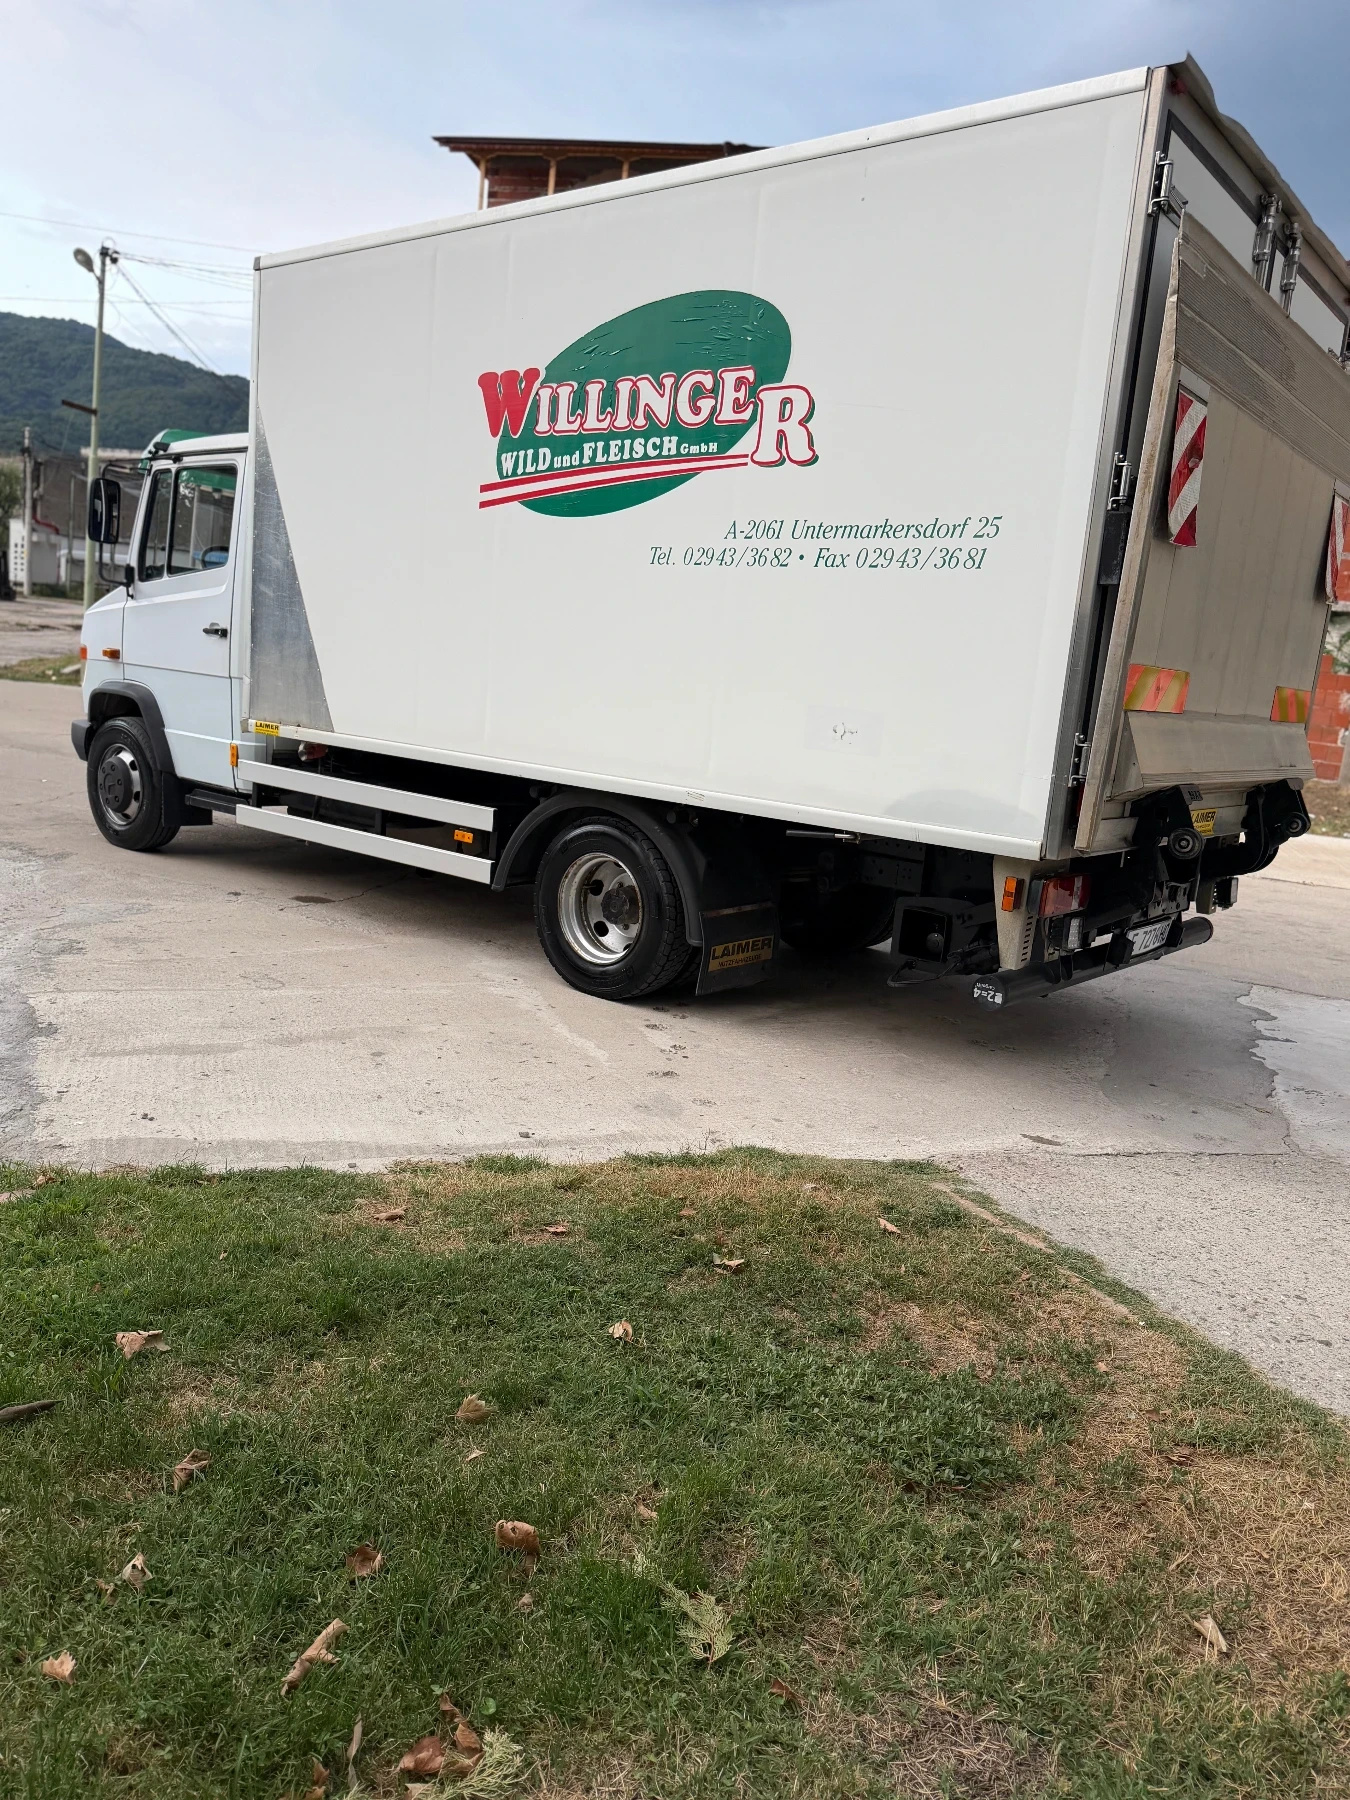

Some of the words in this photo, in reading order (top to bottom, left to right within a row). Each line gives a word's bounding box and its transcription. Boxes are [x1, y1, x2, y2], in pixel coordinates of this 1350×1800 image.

[477, 365, 819, 468] WILLINGER
[500, 447, 551, 477] WILD
[553, 451, 580, 469] und
[582, 436, 678, 465] FLEISCH
[679, 442, 718, 456] GmbH
[723, 519, 786, 541] A-2061
[790, 516, 971, 541] Untermarkersdorf
[972, 515, 1003, 539] 25
[649, 546, 677, 566] Tel.
[682, 546, 793, 569] 02943/3682
[812, 547, 851, 569] Fax
[855, 547, 988, 571] 02943/3681
[256, 722, 279, 731] LAIMER
[711, 937, 773, 960] LAIMER
